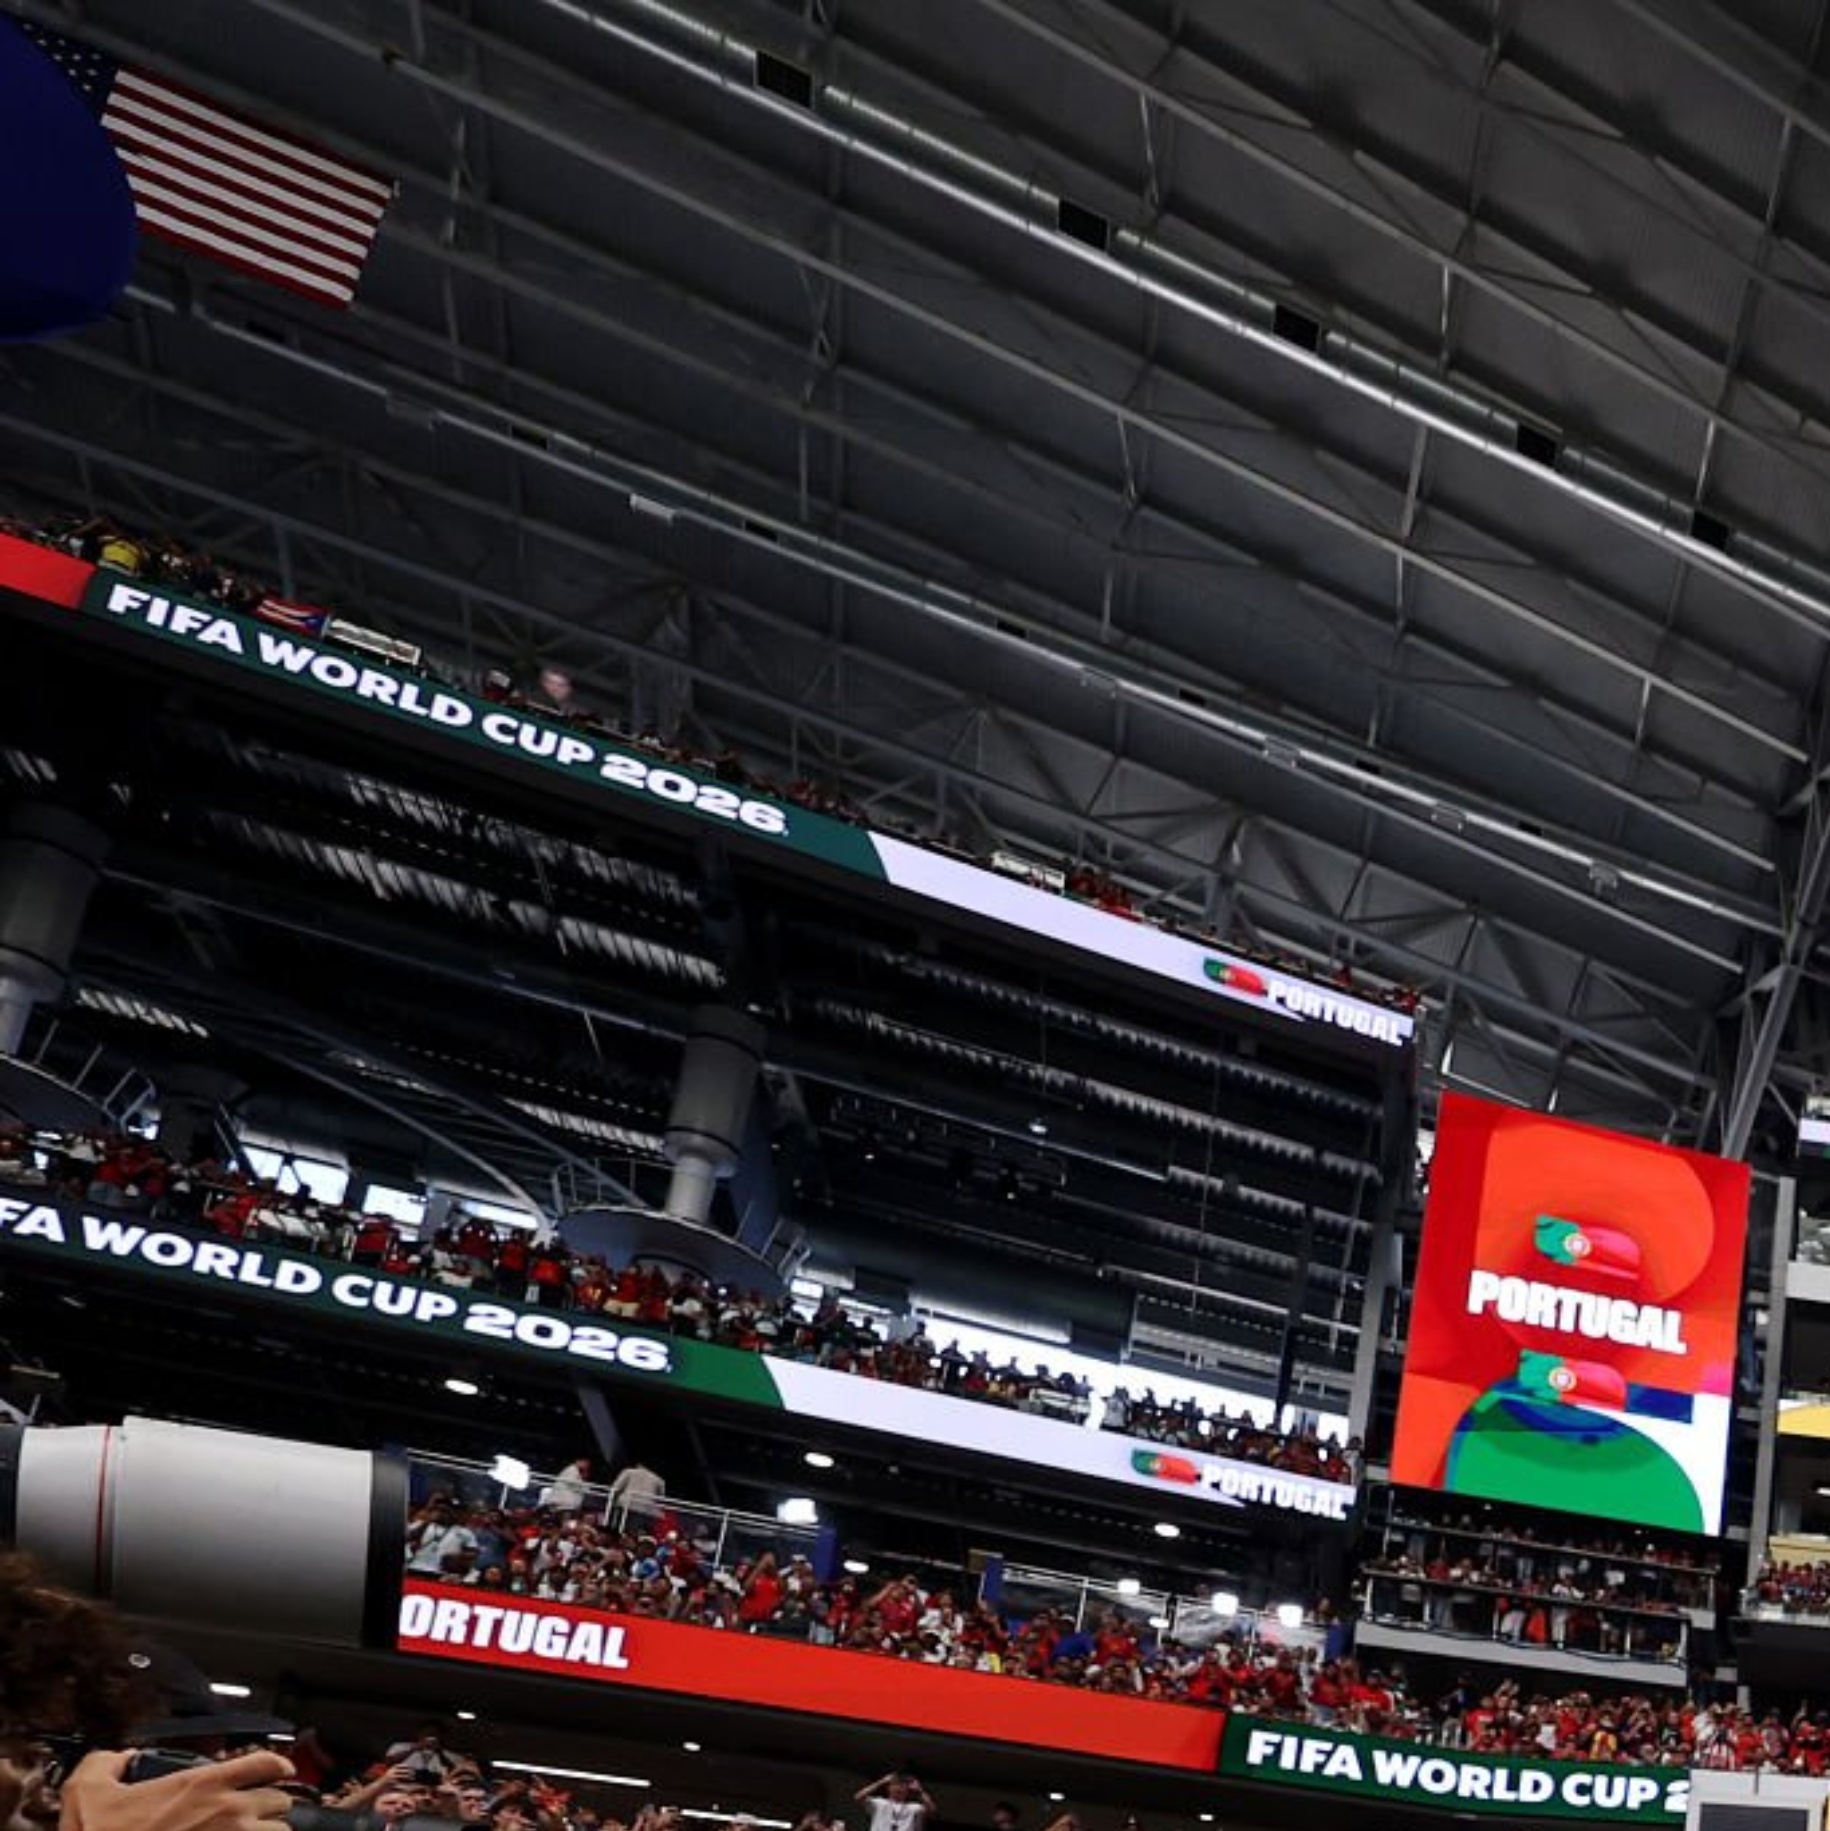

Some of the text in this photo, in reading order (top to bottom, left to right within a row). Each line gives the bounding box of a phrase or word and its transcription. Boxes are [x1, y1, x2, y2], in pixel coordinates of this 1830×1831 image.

[106, 583, 787, 835] FIFA WORLD CUP 2026
[1266, 978, 1405, 1045] PORTUGAL
[82, 1218, 322, 1294] WORLD
[331, 1273, 458, 1324] CUP
[464, 1303, 669, 1374] 2026
[1468, 1270, 1689, 1355] PORTUGAL
[1201, 1462, 1346, 1521] PORTUGAL
[1246, 1730, 1363, 1782] FIFA
[1373, 1750, 1555, 1803] WORLD
[1561, 1772, 1659, 1810] CUP
